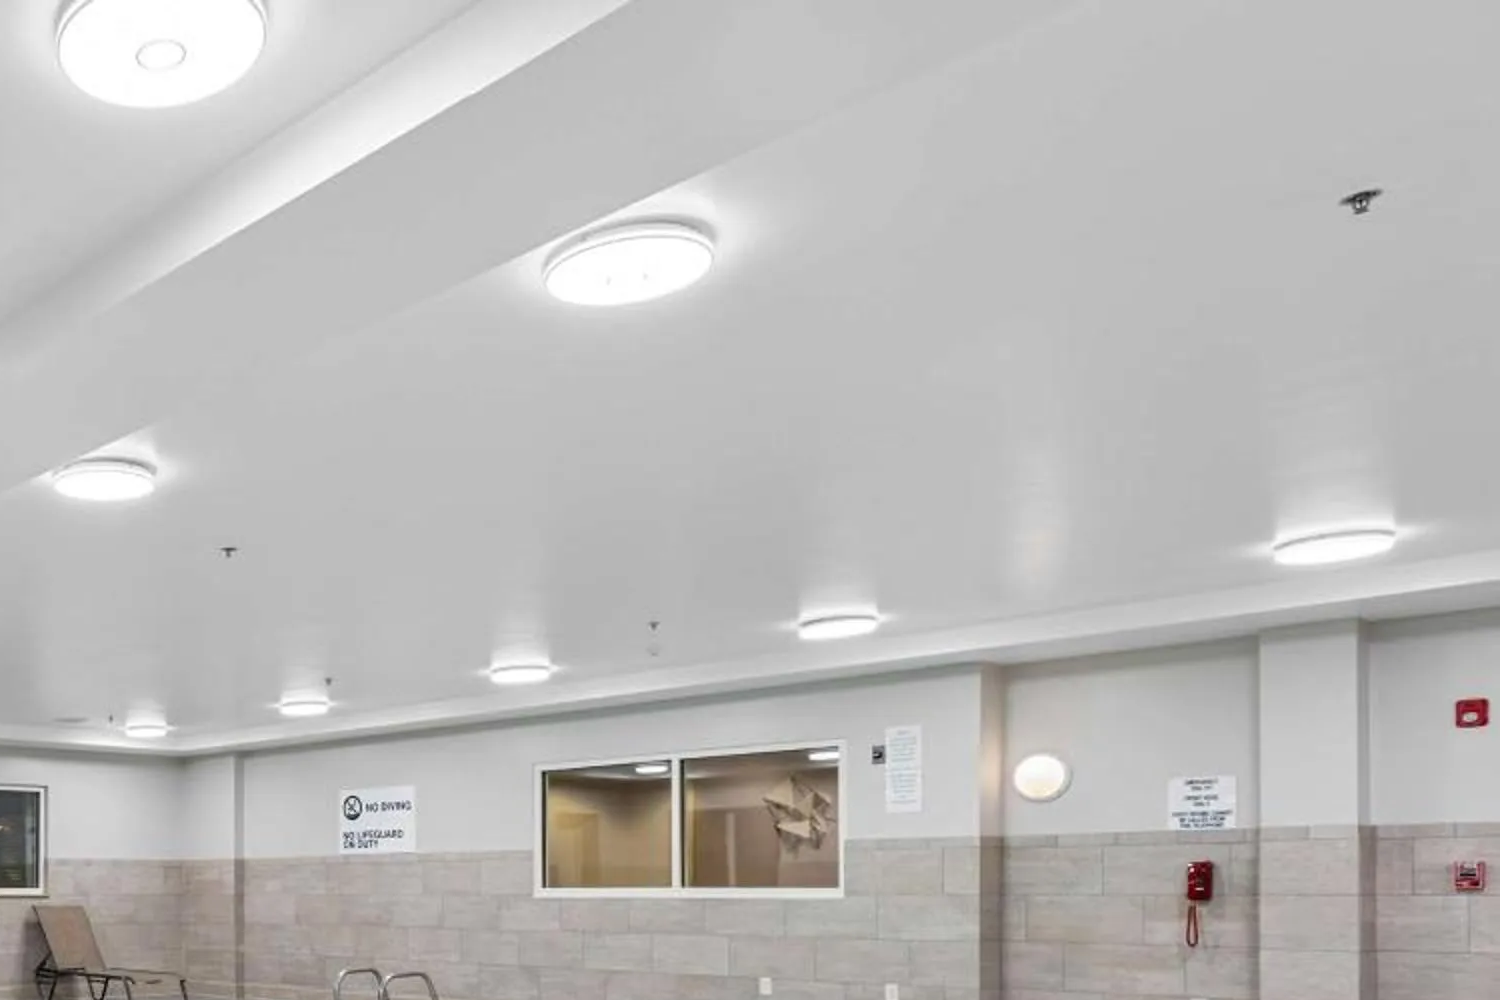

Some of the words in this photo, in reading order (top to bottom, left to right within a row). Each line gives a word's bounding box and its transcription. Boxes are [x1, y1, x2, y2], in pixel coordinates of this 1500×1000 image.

[365, 802, 379, 813] NO
[381, 800, 412, 811] DIVING
[342, 831, 355, 840] NO
[357, 829, 404, 838] LIFEGUARD
[358, 839, 379, 848] DUTY
